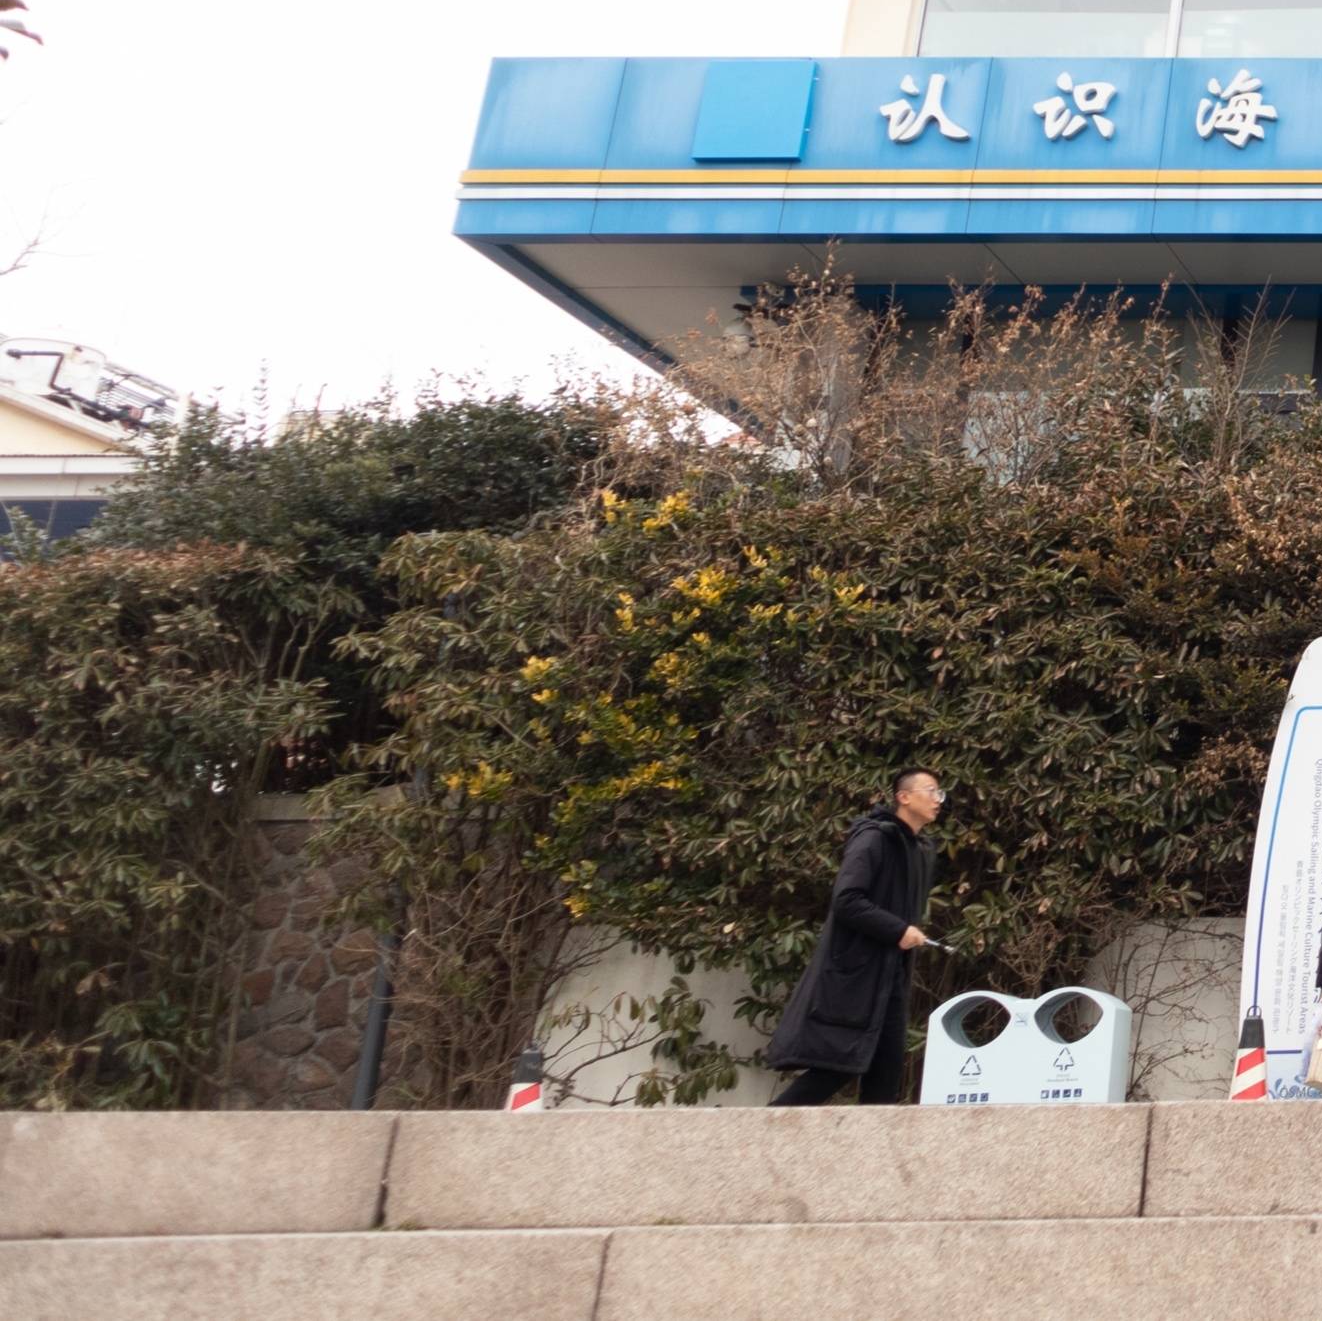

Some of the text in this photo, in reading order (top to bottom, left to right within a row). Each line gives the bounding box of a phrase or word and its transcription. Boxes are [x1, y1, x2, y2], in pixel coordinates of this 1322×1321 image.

[1309, 799, 1322, 840] Olympic
[1307, 841, 1319, 876] Sailing
[1306, 876, 1317, 894] and
[1304, 896, 1316, 931] Marine
[1302, 931, 1314, 969] Culture
[1300, 970, 1311, 1006] Tourist
[1298, 1006, 1309, 1035] Areas
